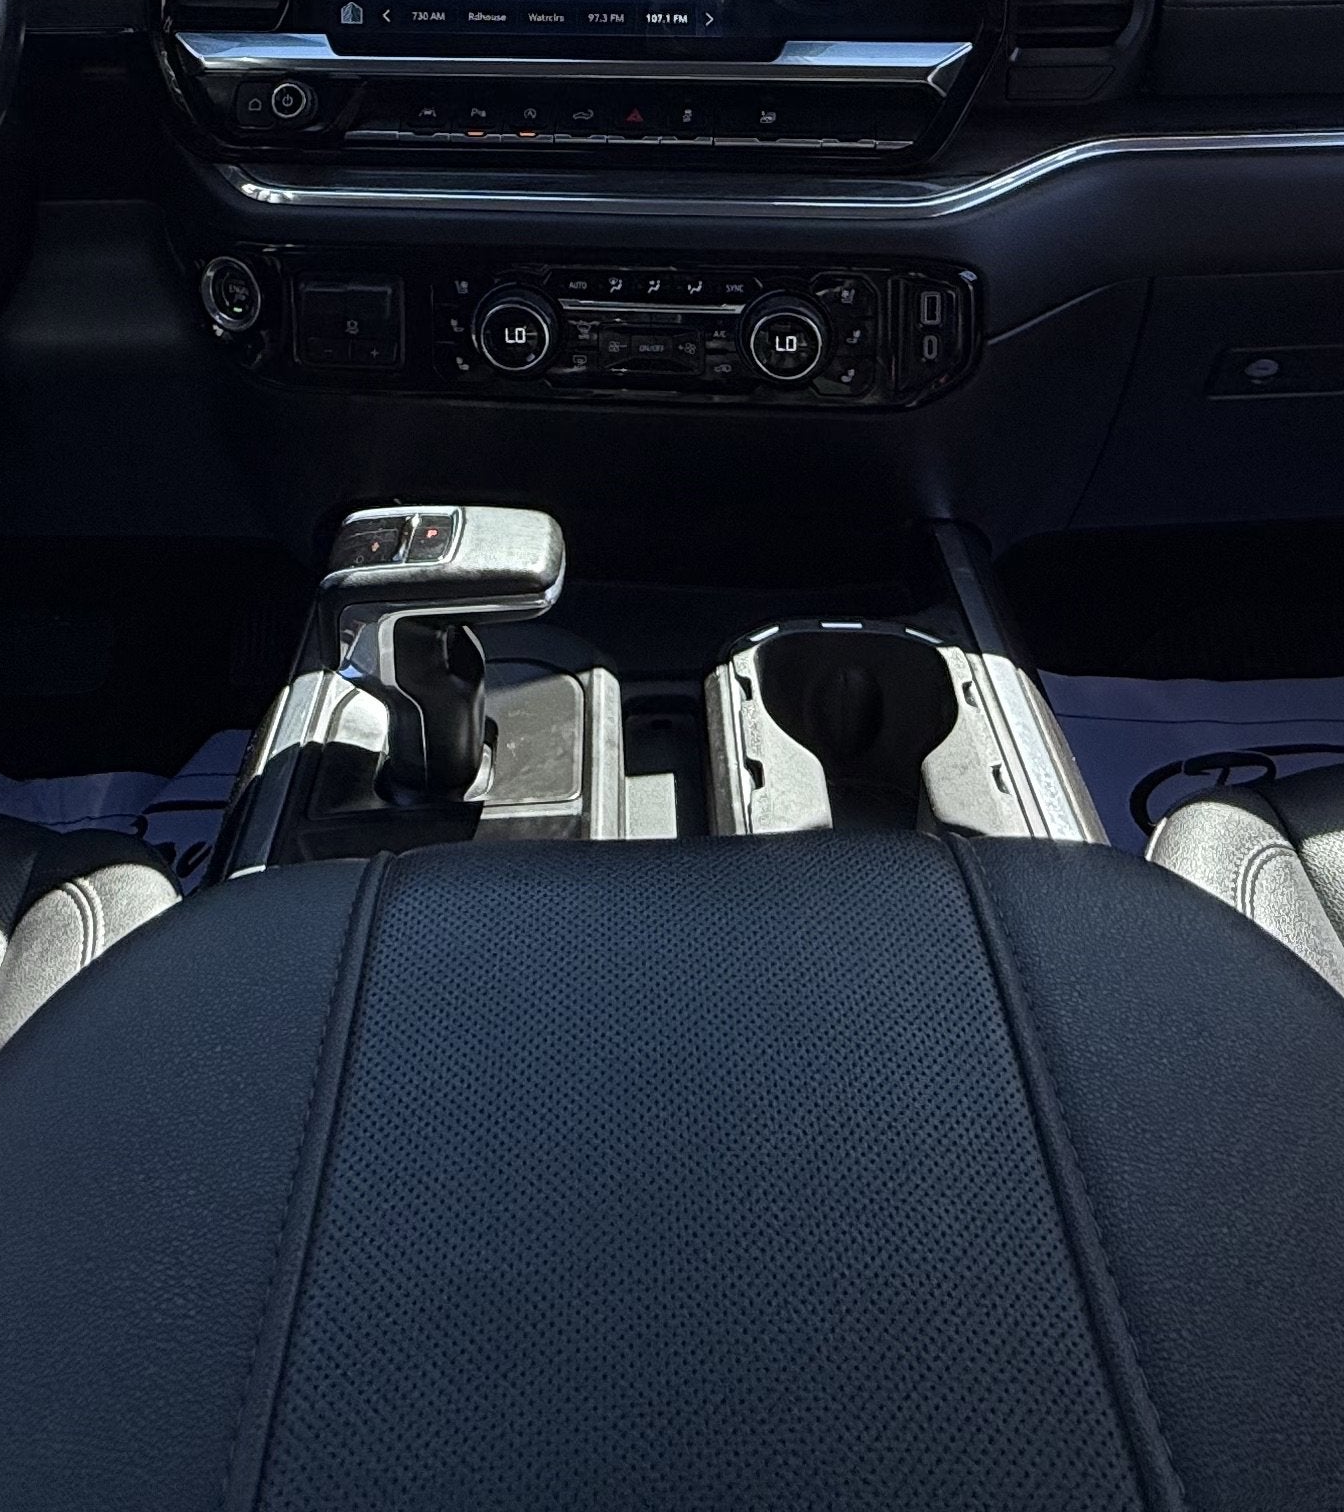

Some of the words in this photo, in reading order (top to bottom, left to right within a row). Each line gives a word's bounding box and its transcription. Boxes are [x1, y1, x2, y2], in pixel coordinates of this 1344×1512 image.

[412, 11, 429, 21] 730
[430, 11, 446, 21] AM
[587, 13, 609, 24] 97.3
[610, 13, 625, 23] FM
[645, 13, 671, 25] 107.1
[672, 13, 689, 25] FM
[568, 280, 588, 291] AUTO
